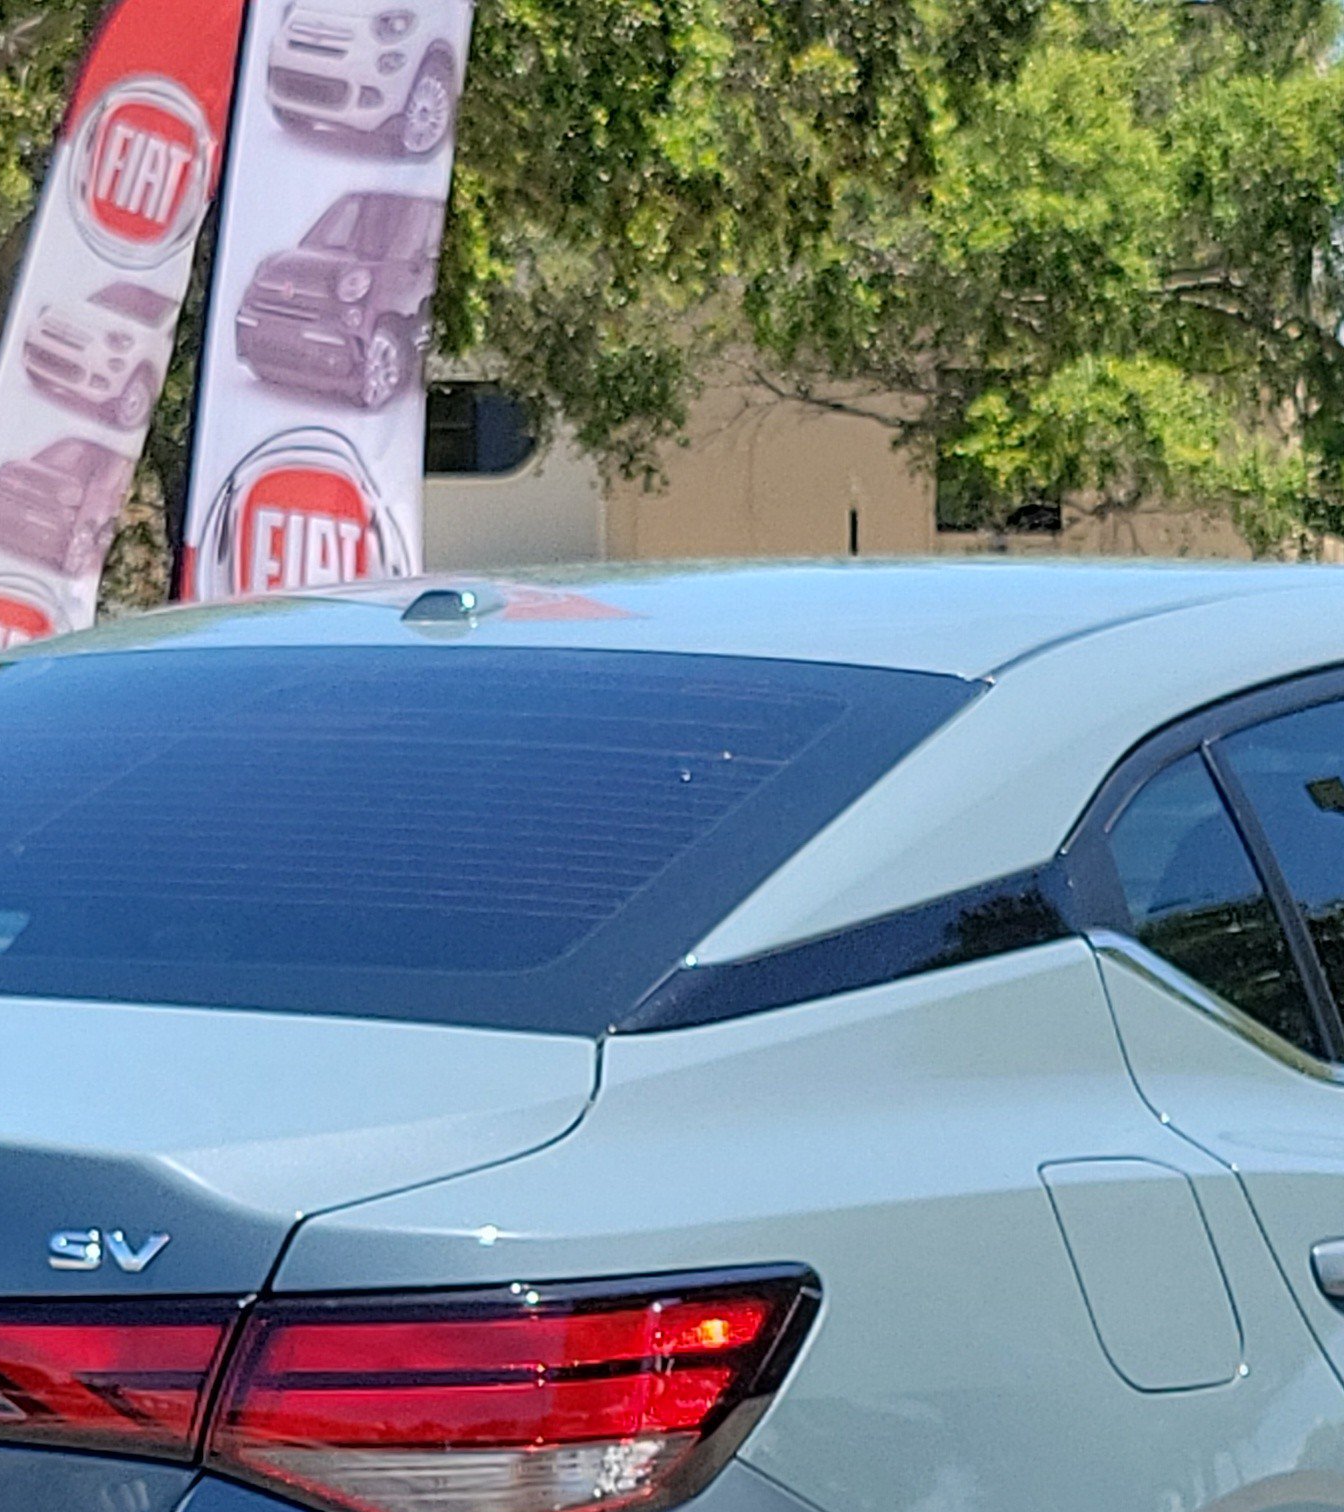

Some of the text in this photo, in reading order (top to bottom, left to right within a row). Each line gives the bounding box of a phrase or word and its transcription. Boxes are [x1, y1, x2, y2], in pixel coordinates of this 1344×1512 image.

[96, 126, 191, 224] FIAT
[252, 508, 361, 593] FIAT
[48, 1229, 171, 1273] SV
